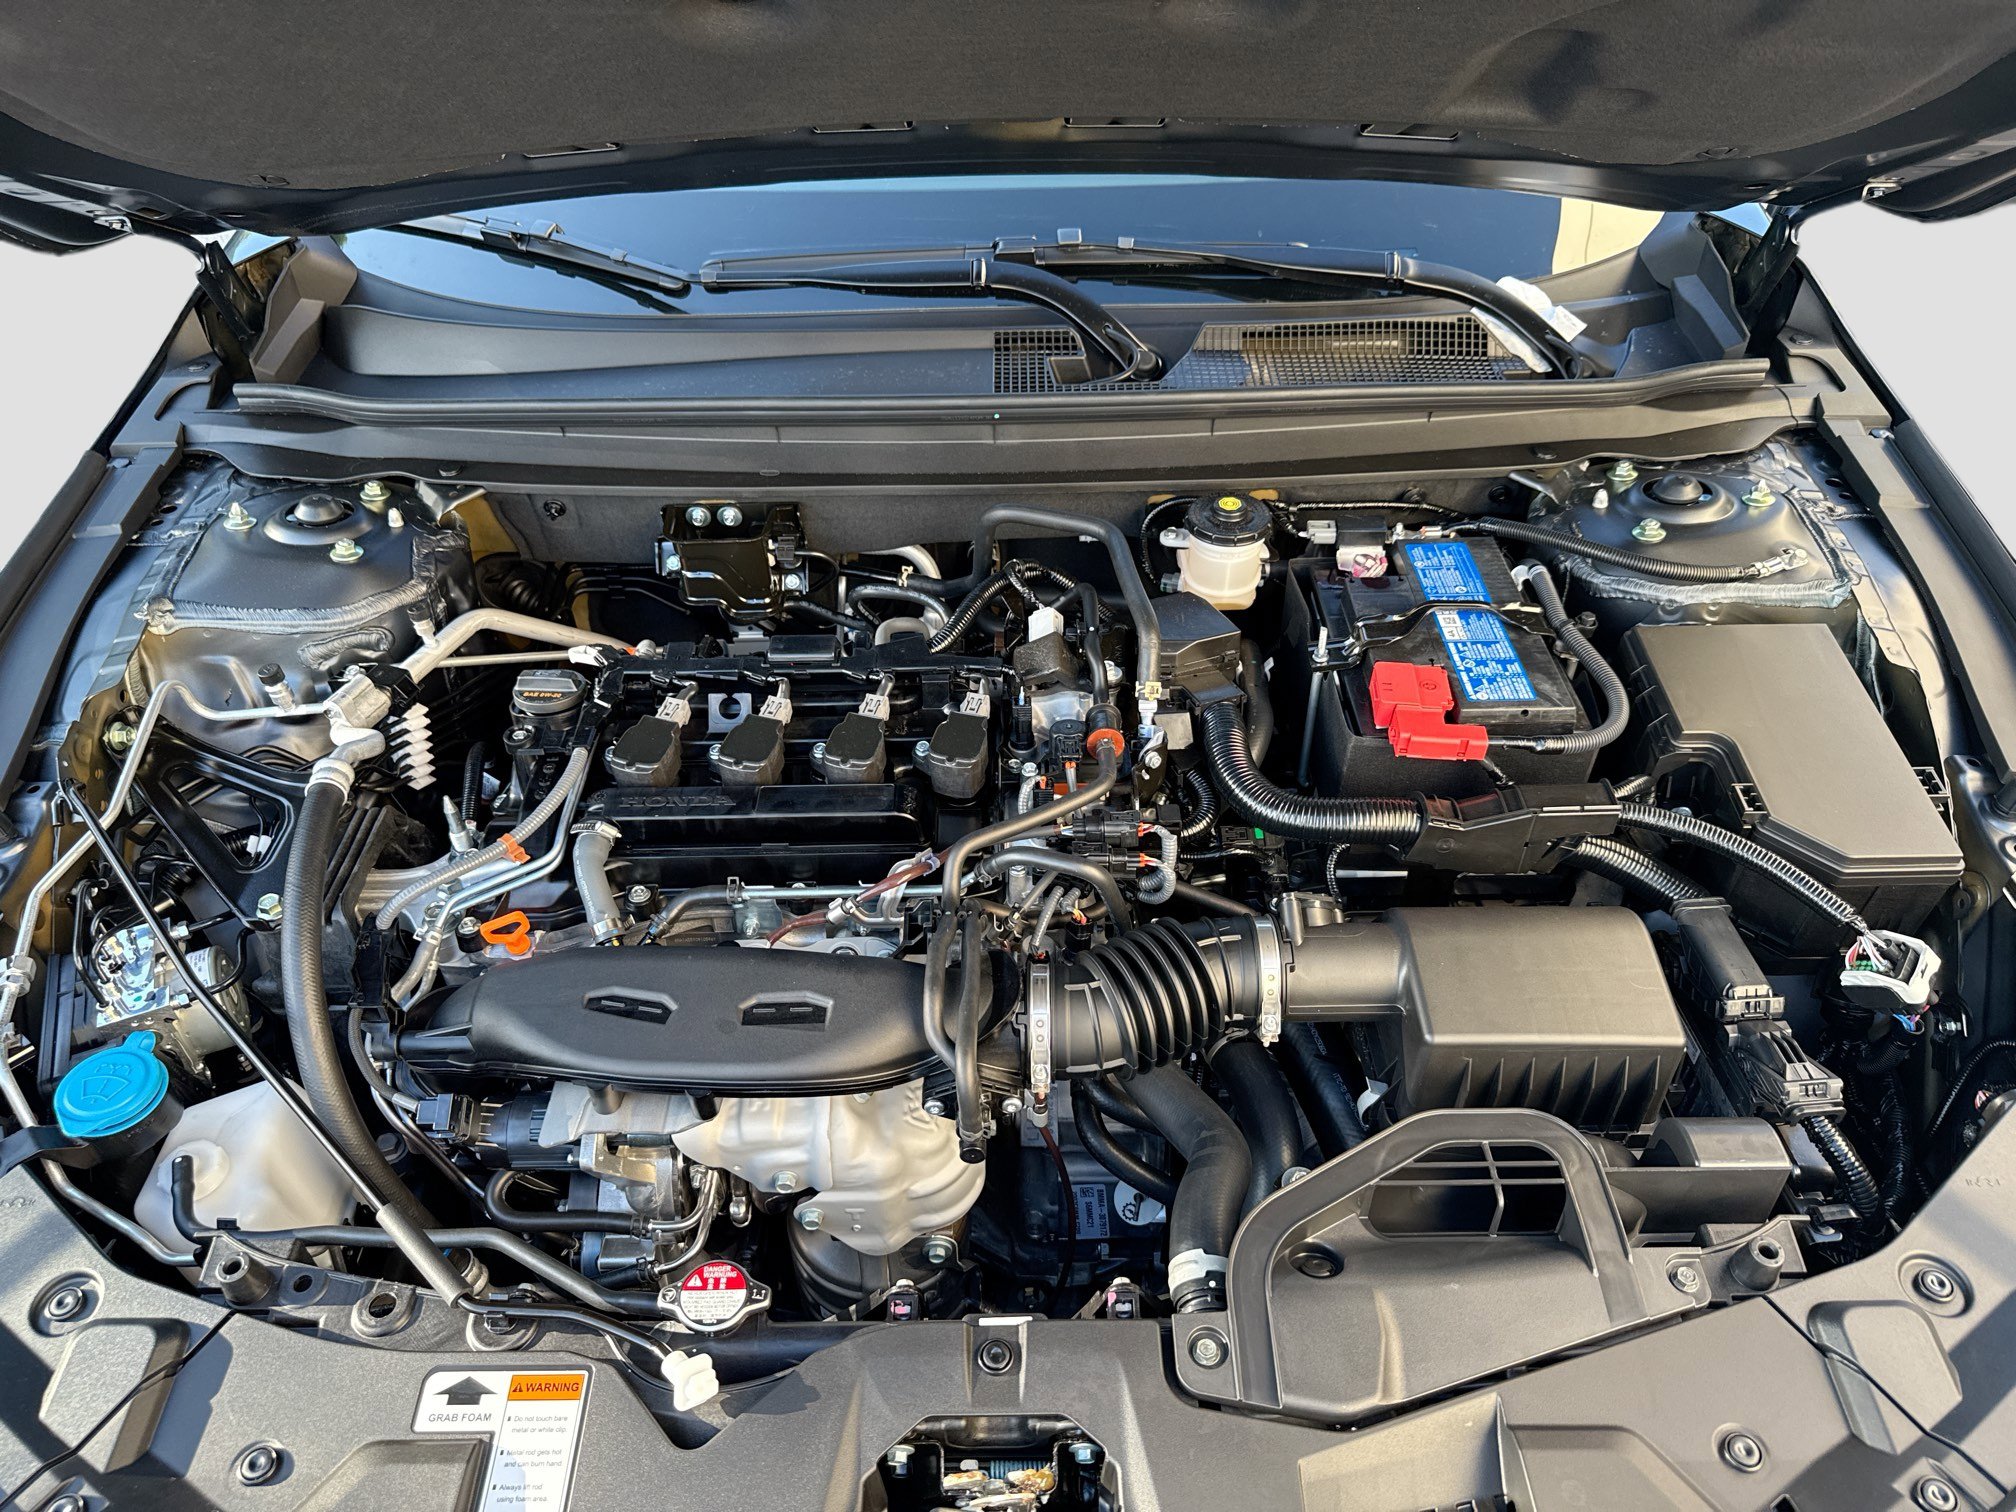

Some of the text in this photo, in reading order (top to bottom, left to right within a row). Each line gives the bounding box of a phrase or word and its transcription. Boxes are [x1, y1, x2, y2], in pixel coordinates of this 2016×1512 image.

[619, 796, 736, 807] HONDA
[526, 1382, 580, 1392] WARNING
[428, 1413, 492, 1422] GRAB FOAM
[537, 1449, 550, 1457] gets
